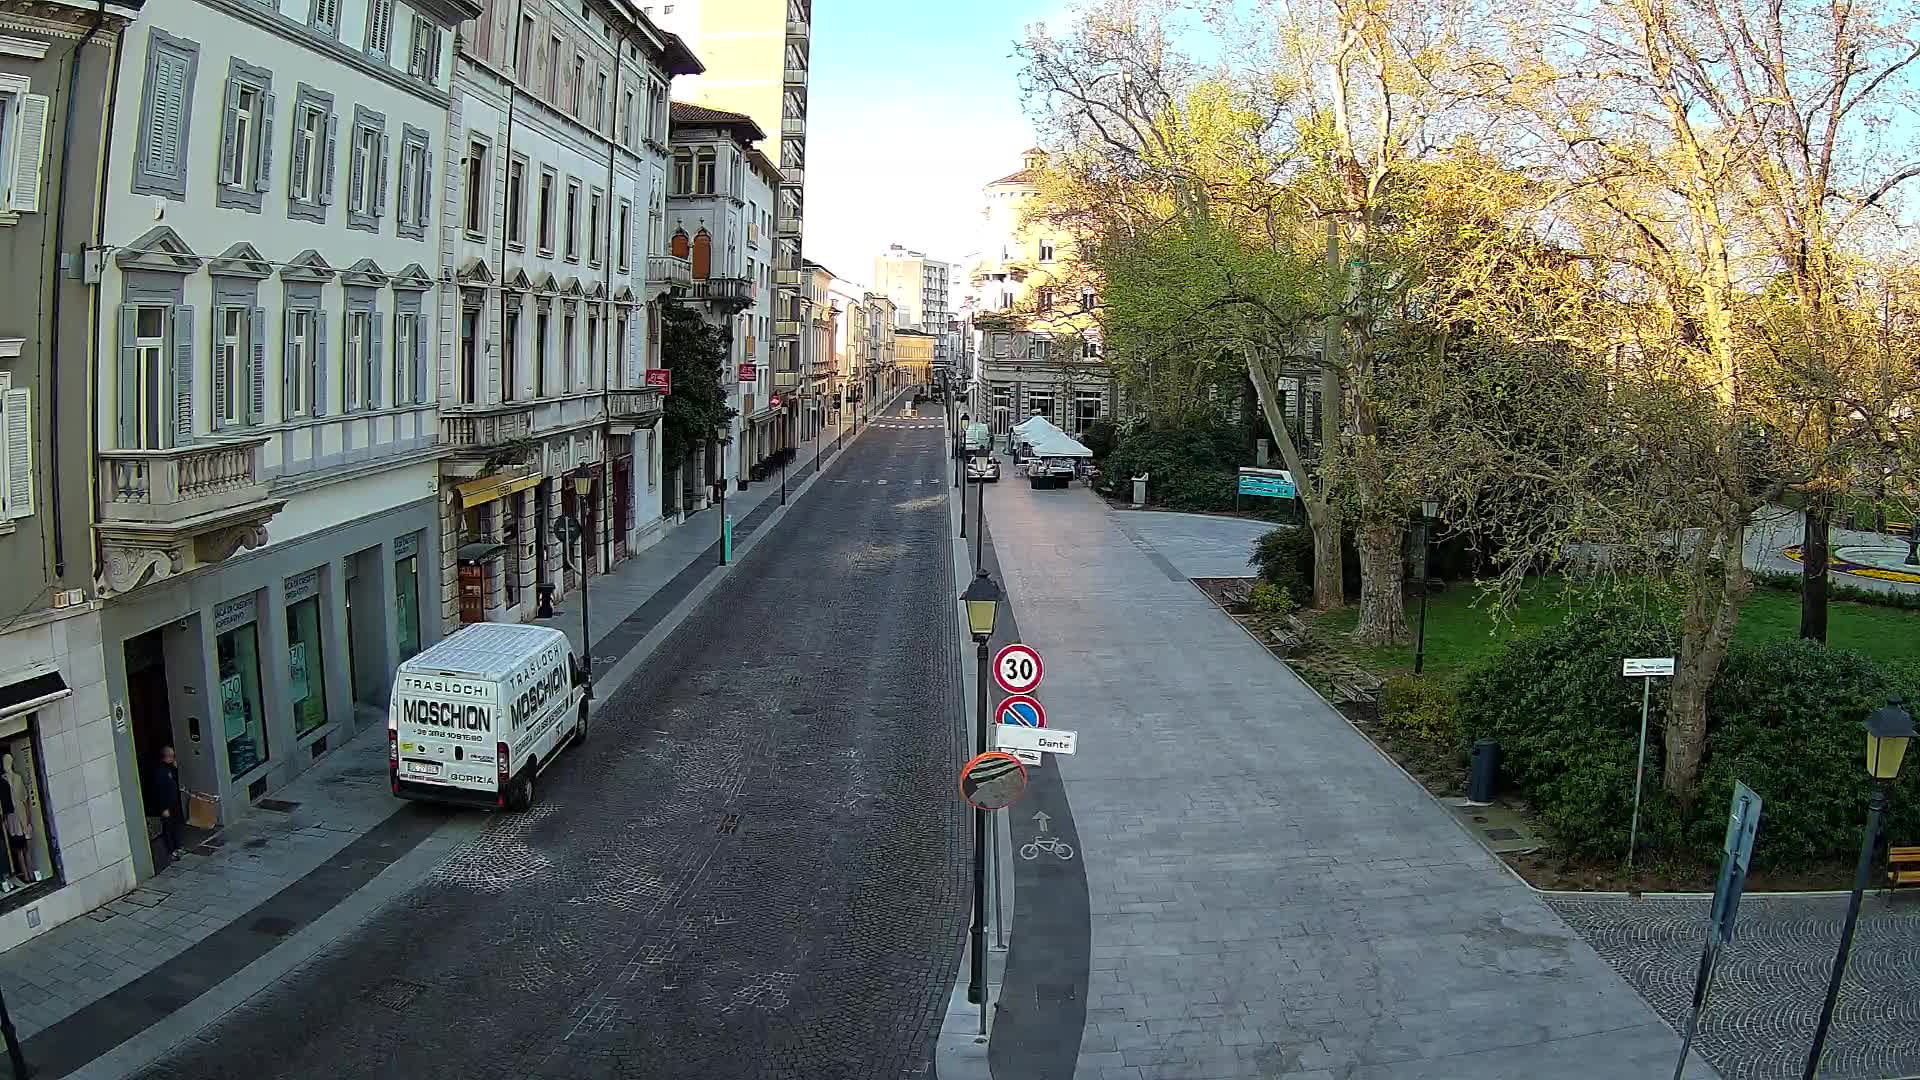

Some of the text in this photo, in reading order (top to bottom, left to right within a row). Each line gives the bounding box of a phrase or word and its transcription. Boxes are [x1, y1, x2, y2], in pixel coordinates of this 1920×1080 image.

[509, 644, 563, 690] TRASLOCHI
[1005, 658, 1033, 680] 30
[404, 678, 488, 696] TRASLOCHI
[510, 659, 567, 732] MOSCHION
[403, 699, 491, 732] MOSCHION
[1038, 738, 1070, 749] Dante
[450, 773, 495, 785] GORIZIA
